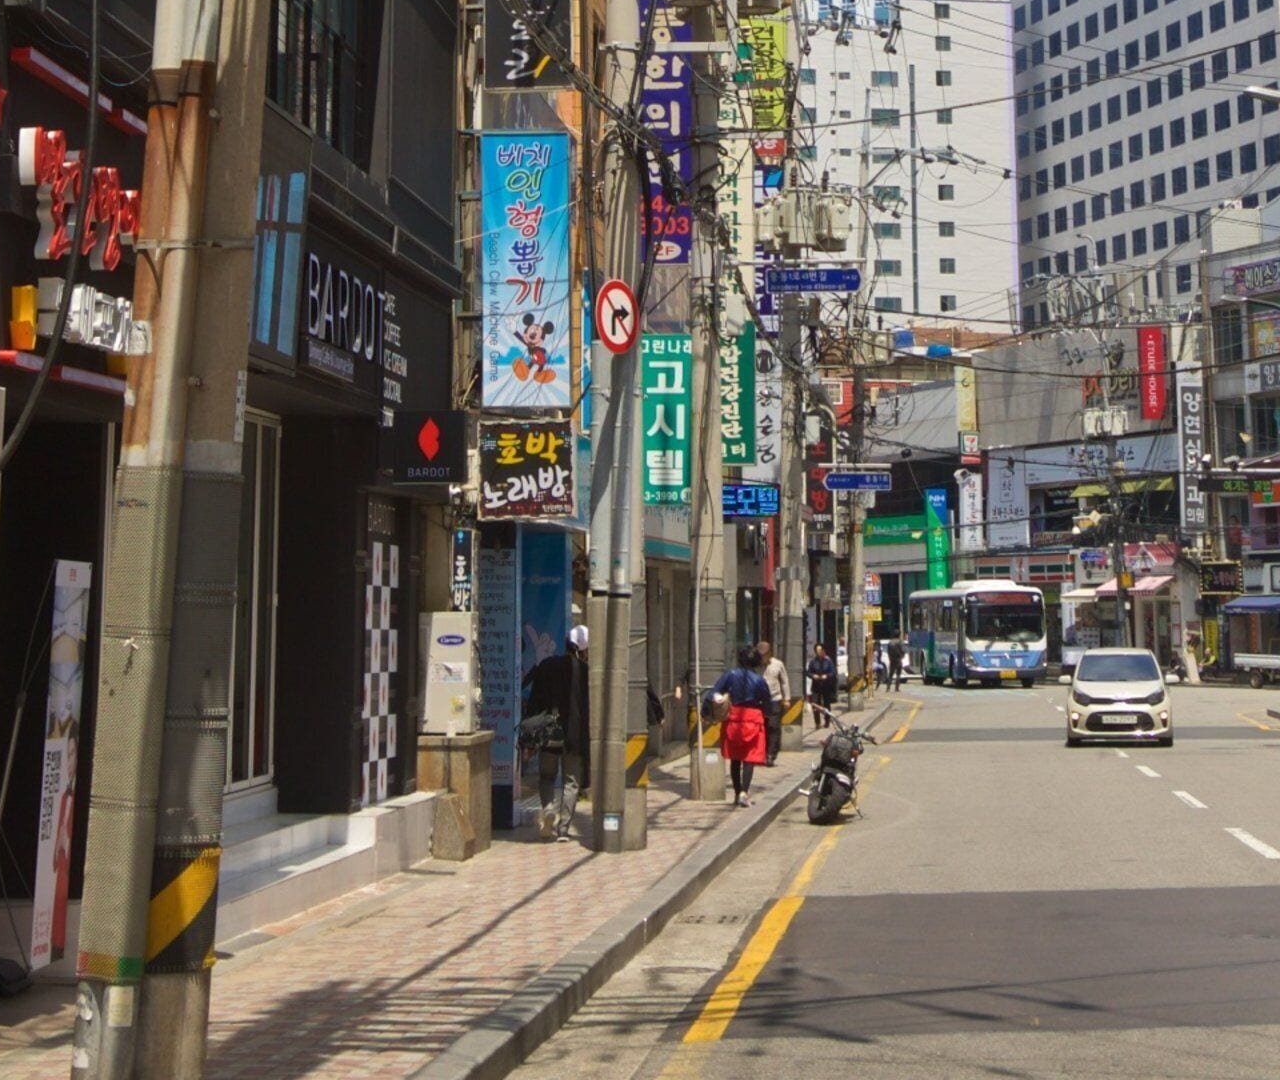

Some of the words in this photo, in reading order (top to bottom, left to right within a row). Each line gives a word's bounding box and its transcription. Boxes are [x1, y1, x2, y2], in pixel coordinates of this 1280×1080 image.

[488, 232, 500, 267] Beach
[504, 167, 547, 306] 인형뽑기
[308, 251, 385, 366] BARDOT
[488, 350, 500, 383] Game
[1147, 339, 1157, 372] ETUDE
[1148, 375, 1158, 408] HOUSE
[646, 360, 686, 486] 고시텔
[496, 430, 565, 463] 호박
[408, 467, 451, 478] BARDOT
[484, 464, 570, 509] 노래방
[928, 494, 945, 502] NH
[1186, 508, 1205, 523] 의원
